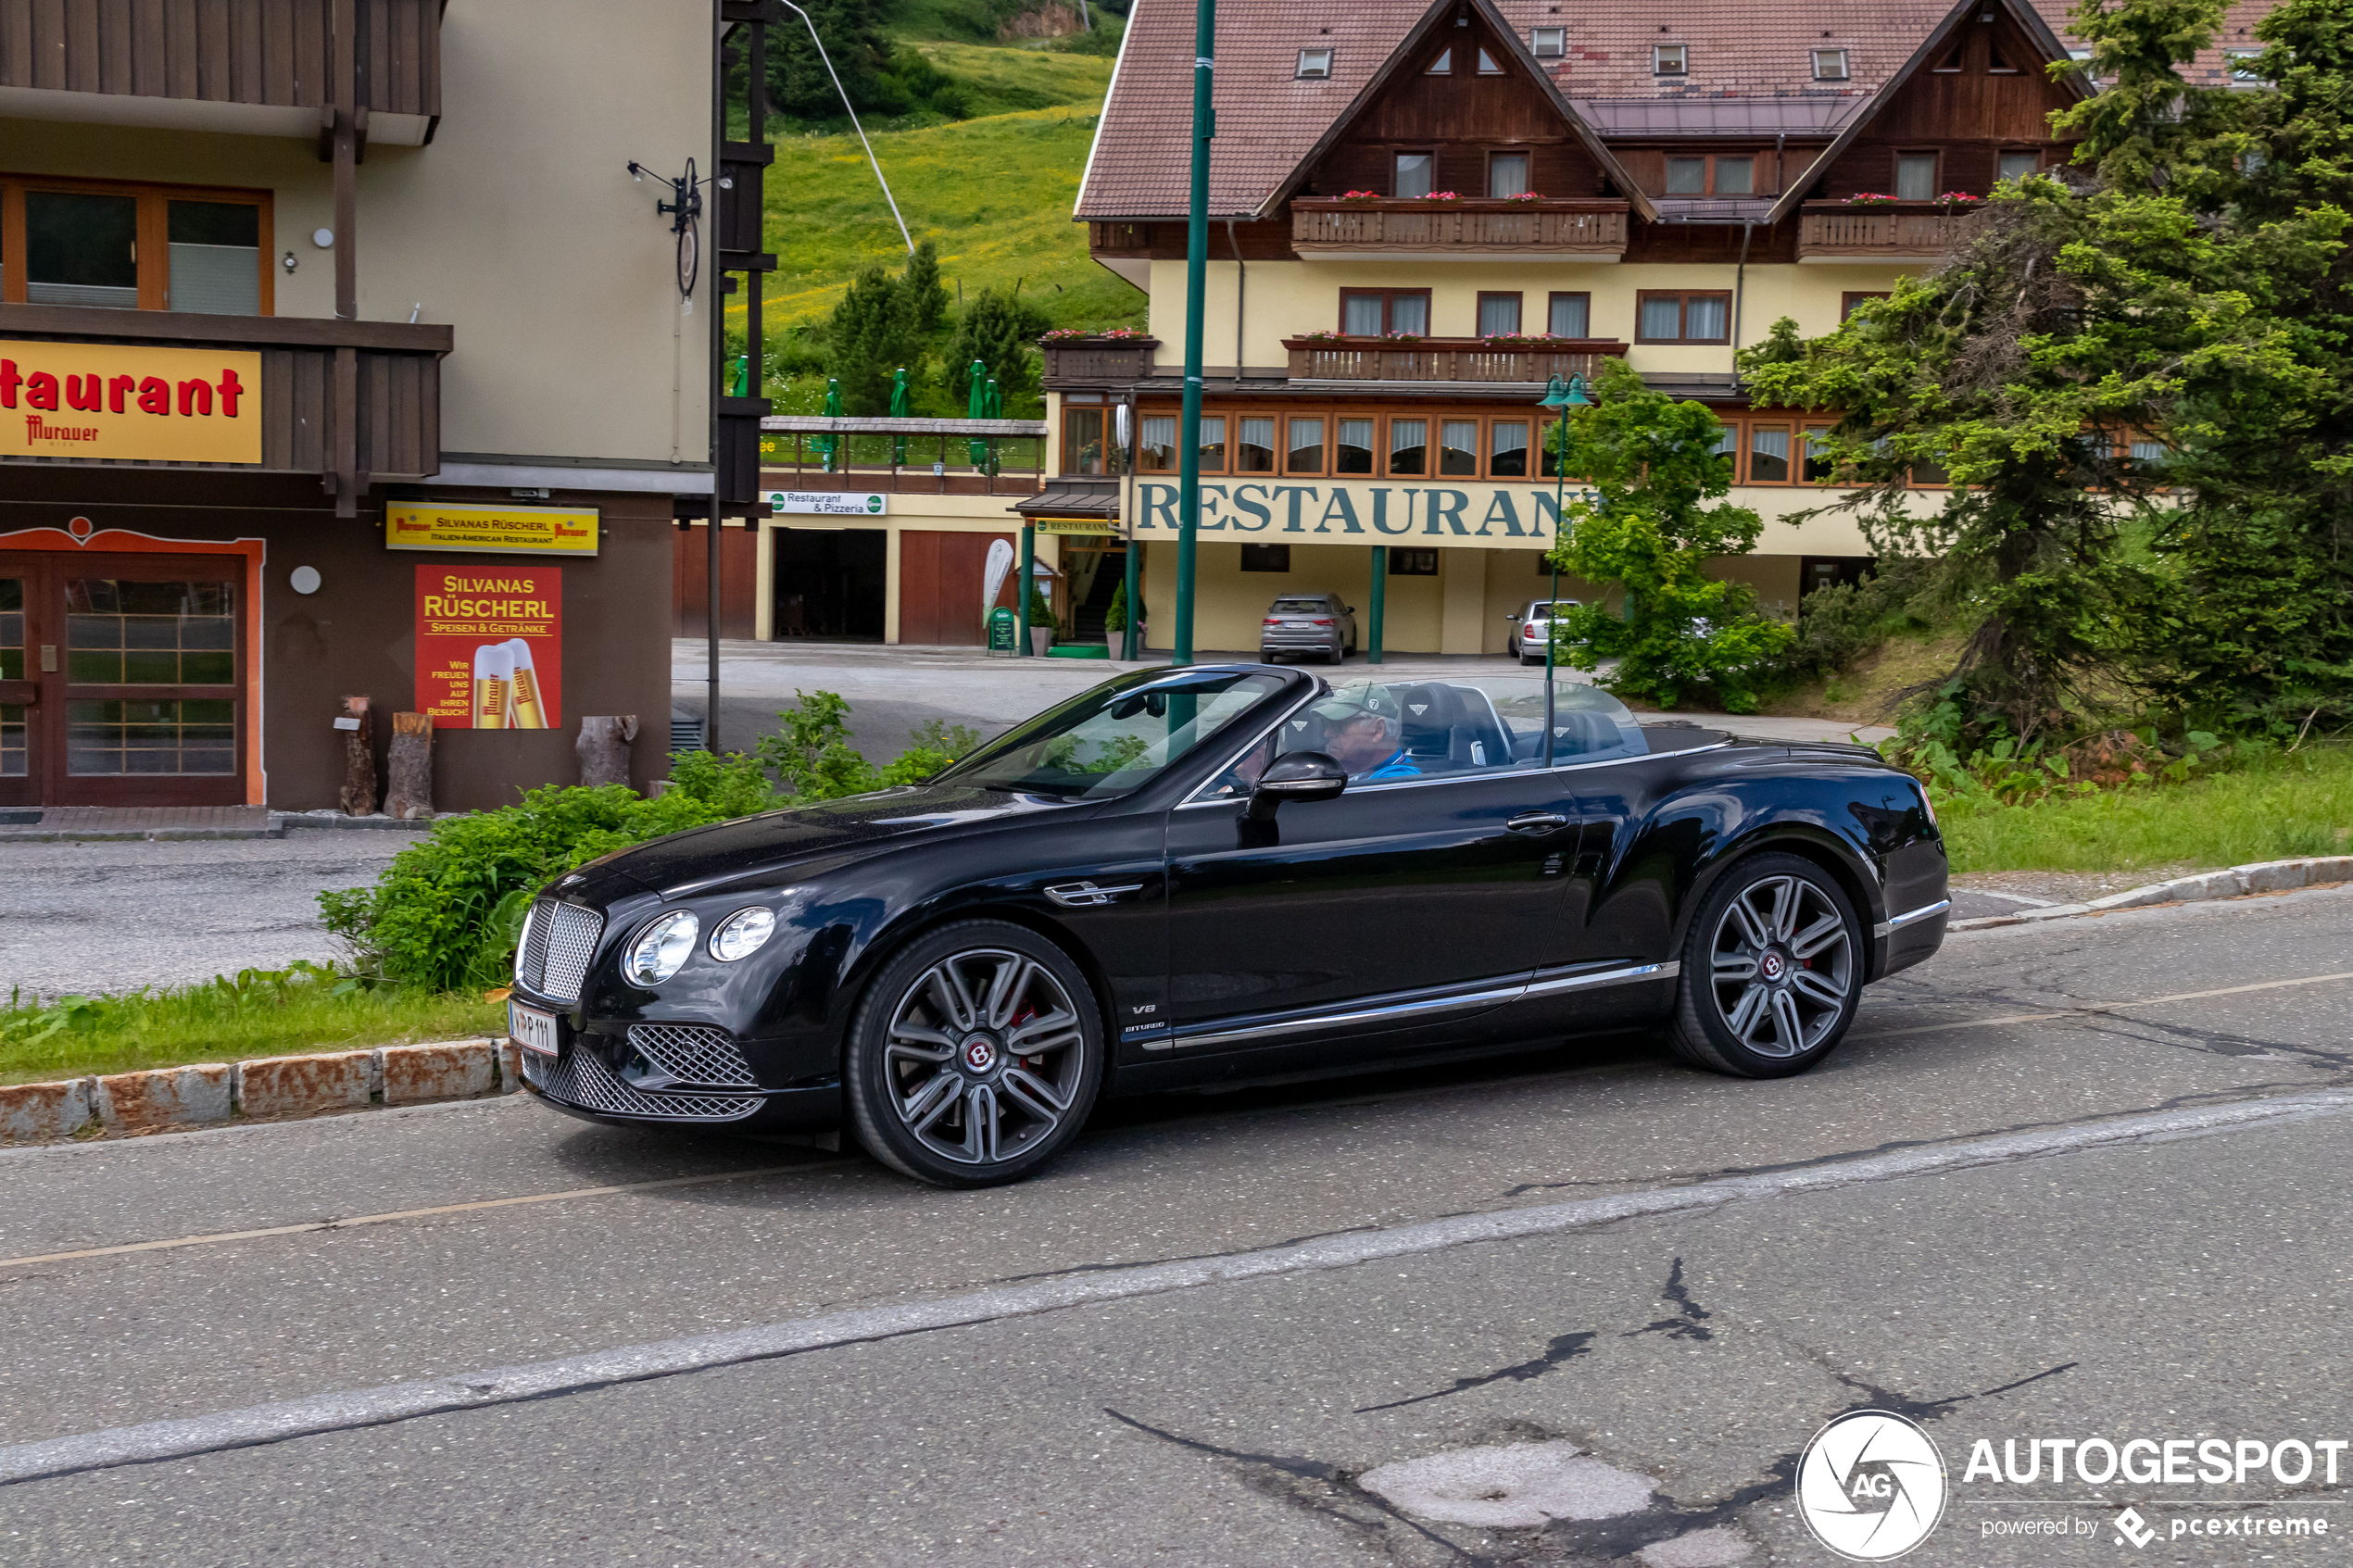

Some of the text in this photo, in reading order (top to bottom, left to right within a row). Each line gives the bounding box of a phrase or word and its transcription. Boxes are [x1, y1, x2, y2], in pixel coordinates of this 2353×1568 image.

[26, 414, 99, 446] Murauer
[787, 493, 841, 503] Restaurant
[814, 503, 822, 512] &
[824, 503, 863, 514] Pizzeria
[436, 518, 549, 532] SILVANAS RÜSCHERL
[503, 535, 553, 544] RESTAURANT
[444, 575, 535, 594] SILVANAS
[424, 594, 555, 618] RÜSCHERL
[431, 622, 547, 633] SPEISEN & GETRÄNKE
[449, 660, 469, 670] WIR
[1371, 700, 1378, 709] 7
[427, 708, 469, 716] BESUCH!
[1132, 1005, 1156, 1015] V8
[1126, 1022, 1165, 1033] BITURBO
